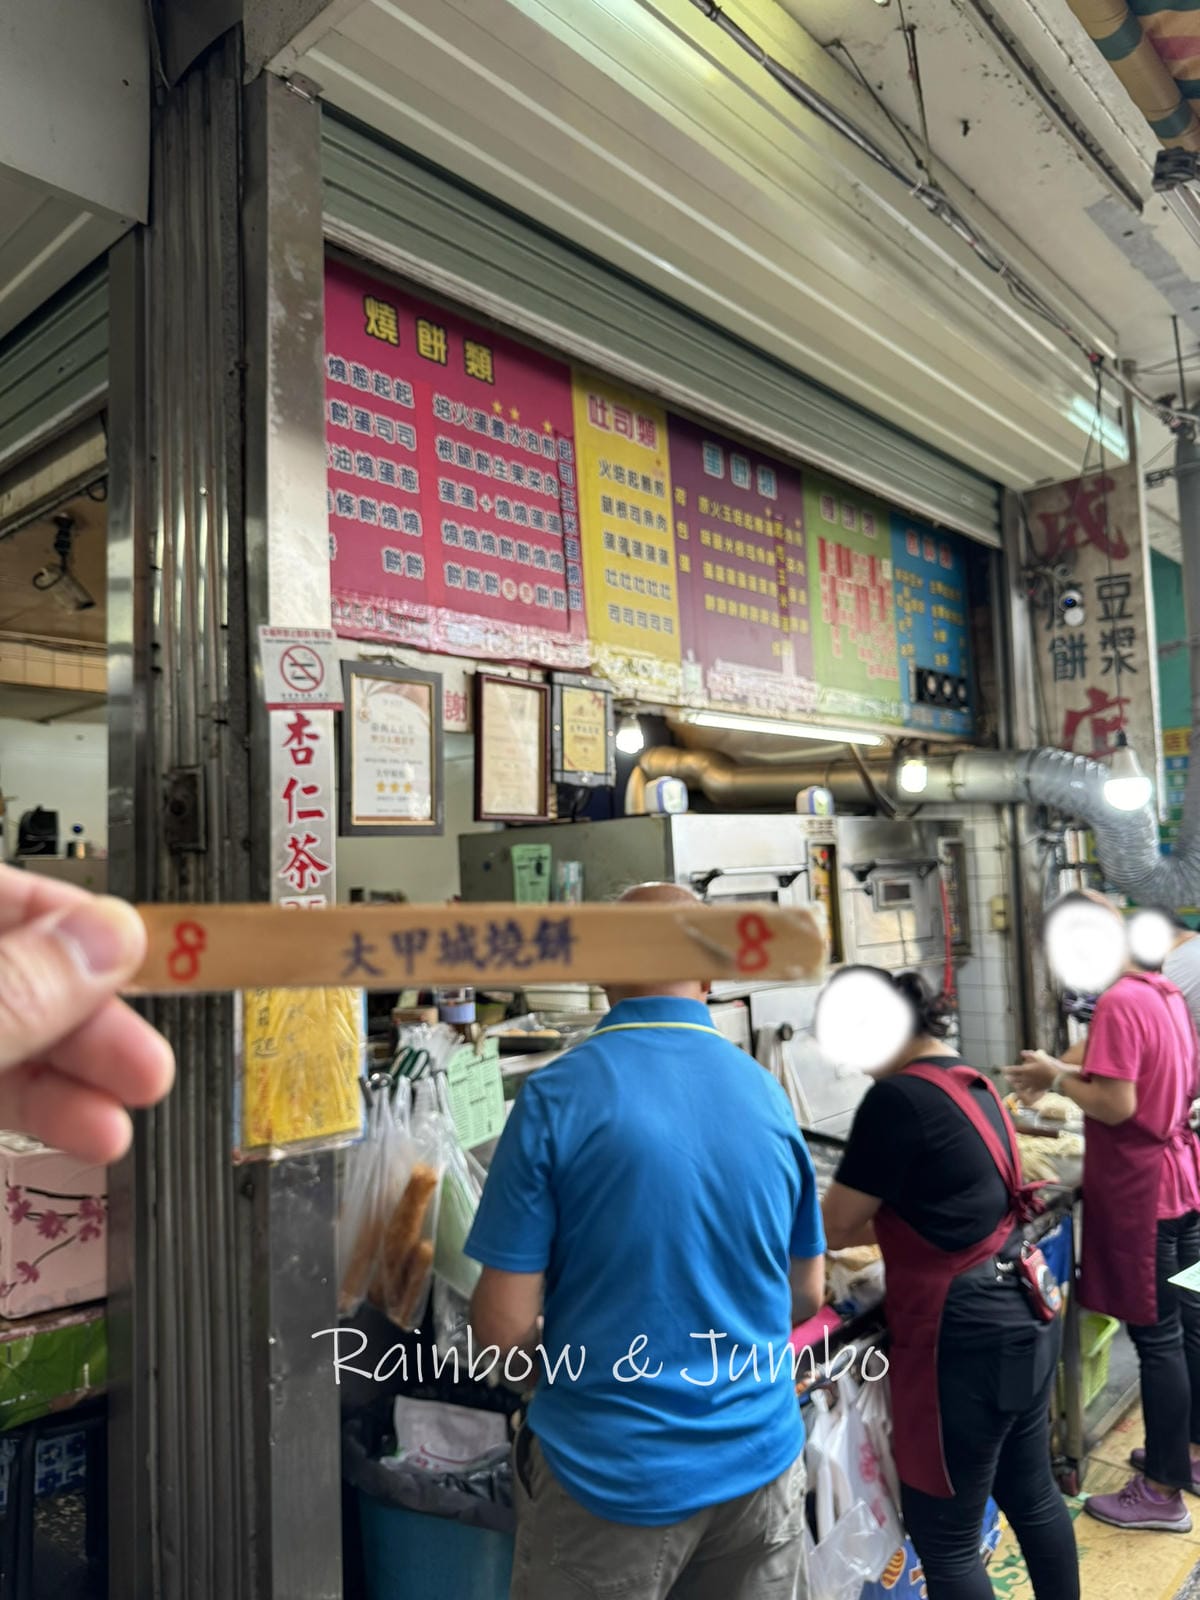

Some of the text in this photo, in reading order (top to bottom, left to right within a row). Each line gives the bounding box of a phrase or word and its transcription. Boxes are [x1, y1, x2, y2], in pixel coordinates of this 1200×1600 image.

[364, 296, 495, 385] 燒餅類
[588, 392, 658, 452] 吐司類
[372, 370, 403, 576] 起司蛋燒餅
[1095, 573, 1137, 676] 豆漿
[281, 712, 330, 890] 杏仁茶
[167, 921, 206, 982] 8
[341, 917, 578, 979] 大甲城燒餅
[735, 911, 773, 974] 8
